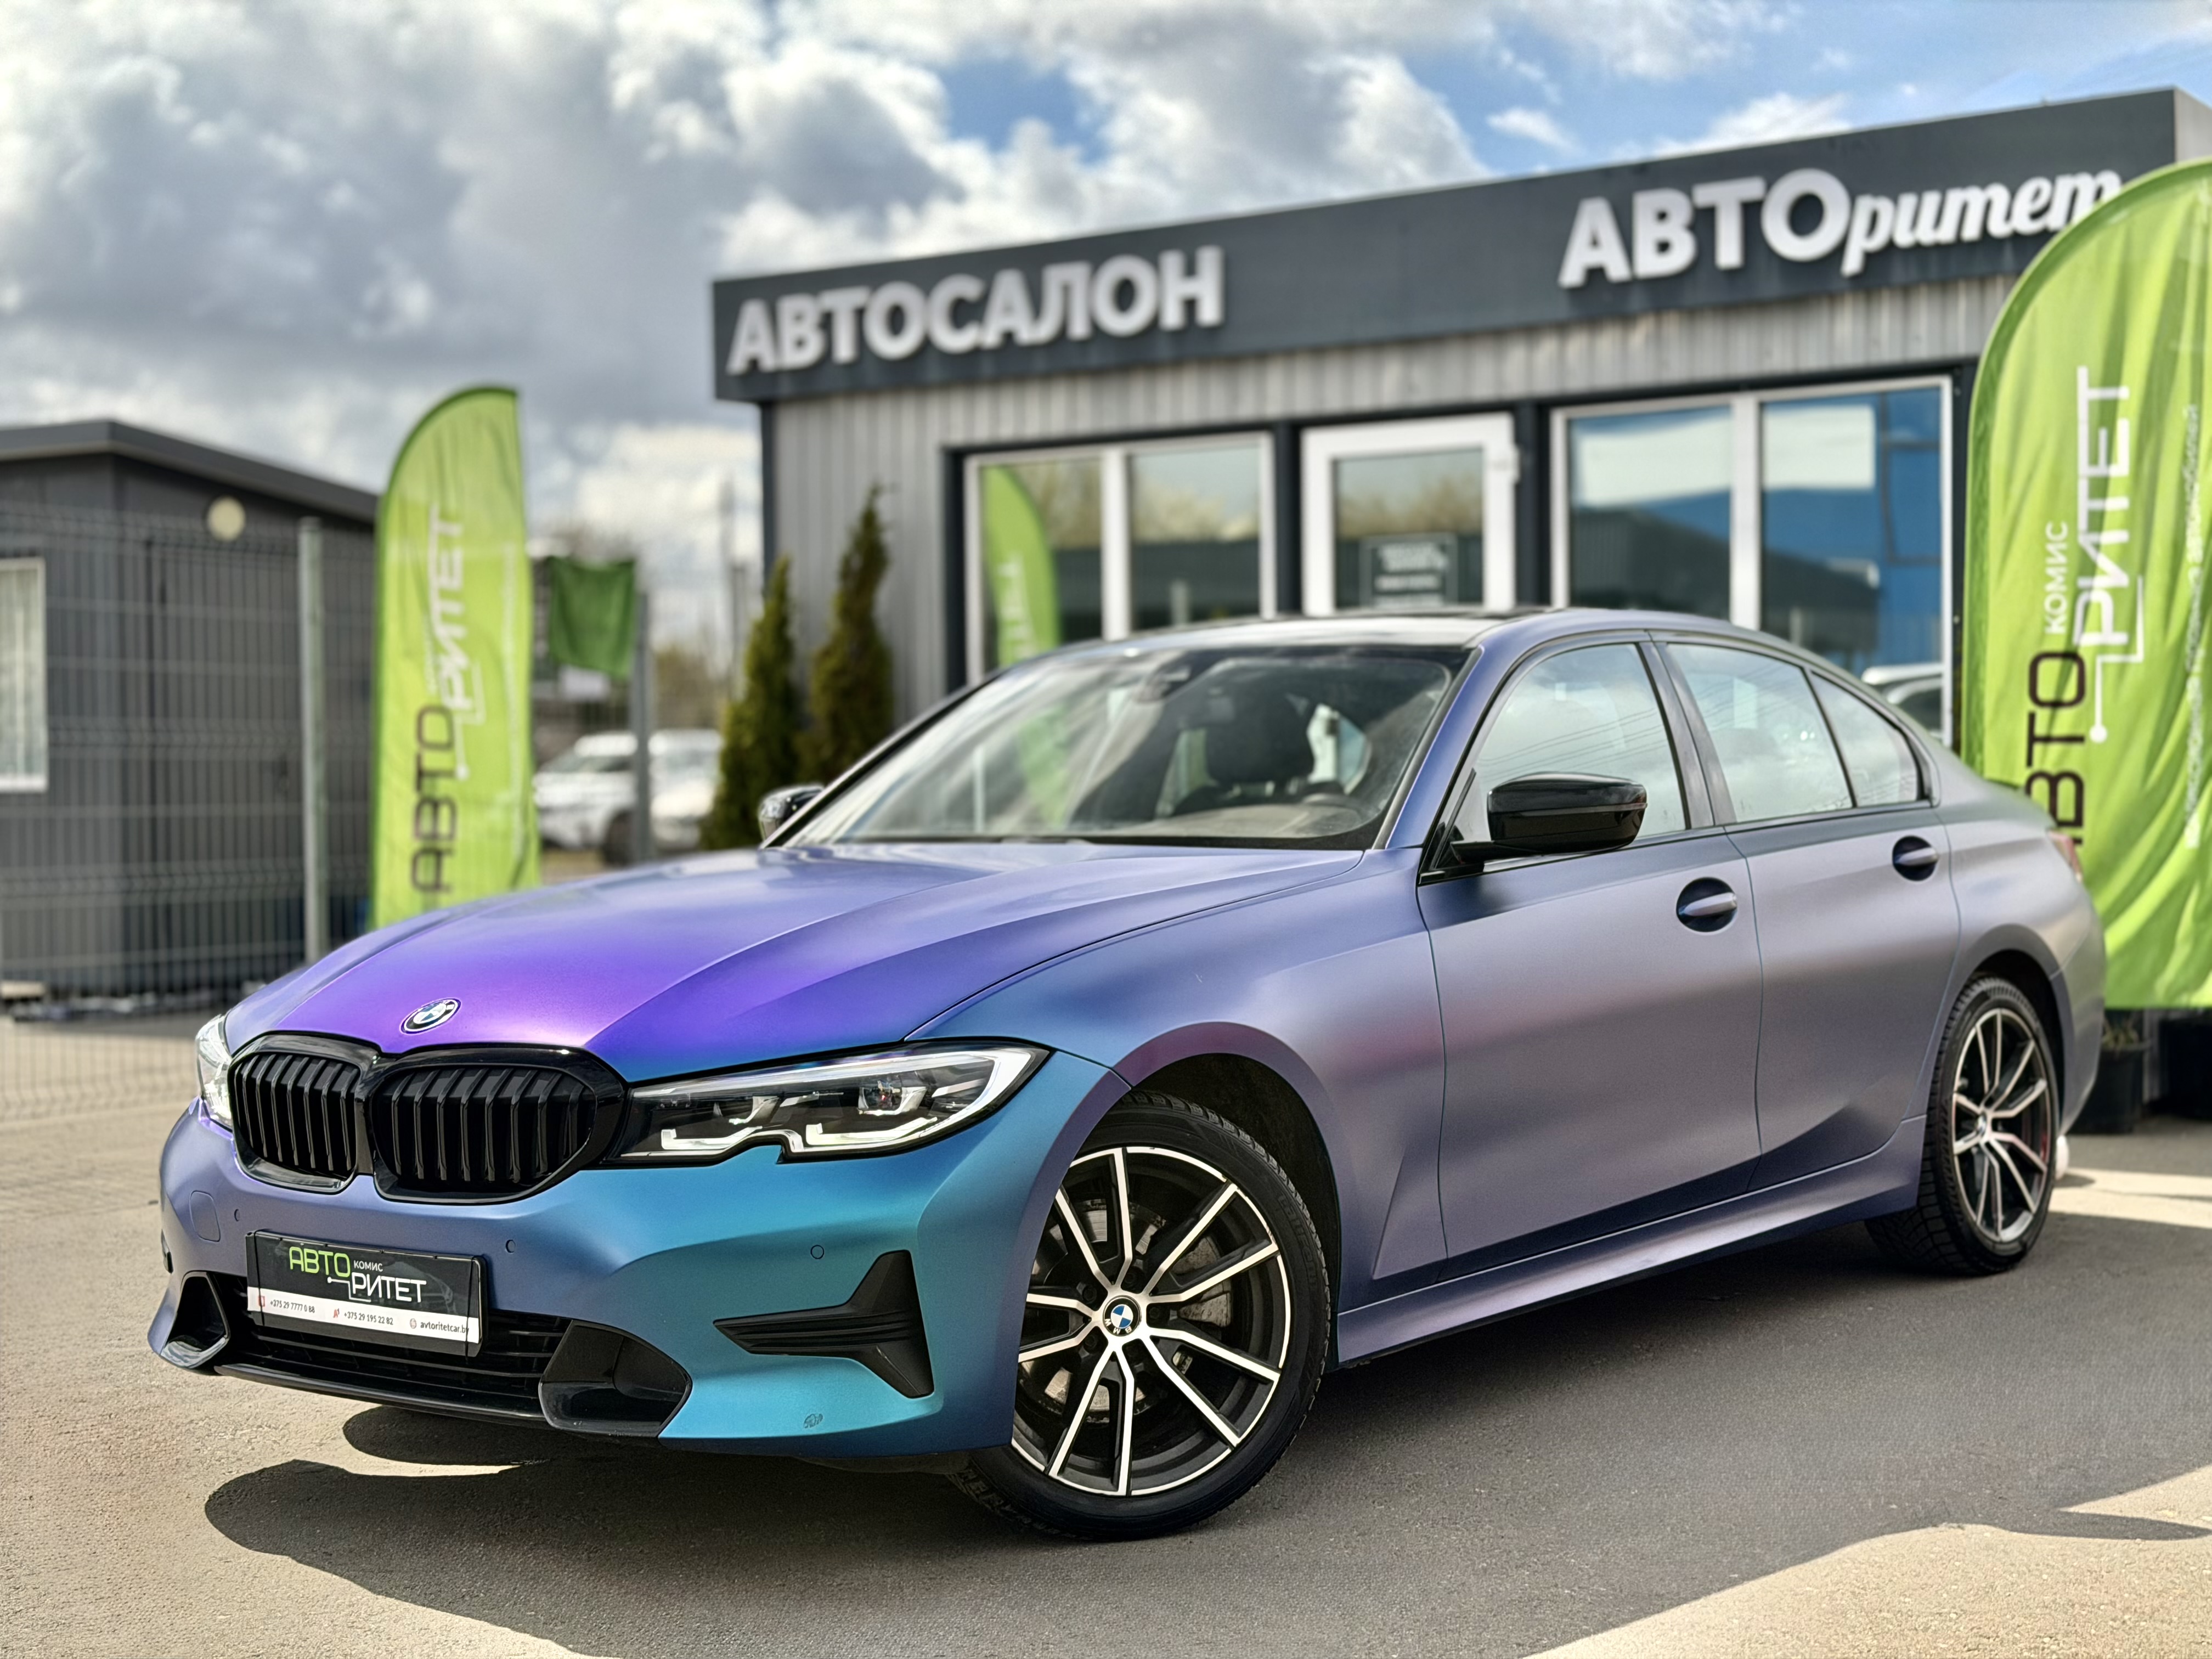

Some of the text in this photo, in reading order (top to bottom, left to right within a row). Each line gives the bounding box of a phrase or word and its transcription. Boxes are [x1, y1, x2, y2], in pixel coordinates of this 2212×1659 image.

[727, 245, 1223, 375] АВТОСАЛОН
[2072, 366, 2130, 646] РИТЕТ
[2044, 521, 2068, 635] КОМИС
[2024, 651, 2086, 845] ВТО
[410, 704, 458, 893] АВТО
[289, 1246, 351, 1278] АВТО
[352, 1272, 427, 1303] РИТЕТ
[353, 1260, 383, 1272] КОМИС
[343, 1311, 357, 1320] +375
[358, 1313, 365, 1321] 29
[366, 1314, 377, 1323] 195
[377, 1316, 385, 1324] 22
[386, 1317, 393, 1325] 82
[1104, 1318, 1132, 1335] BMW
